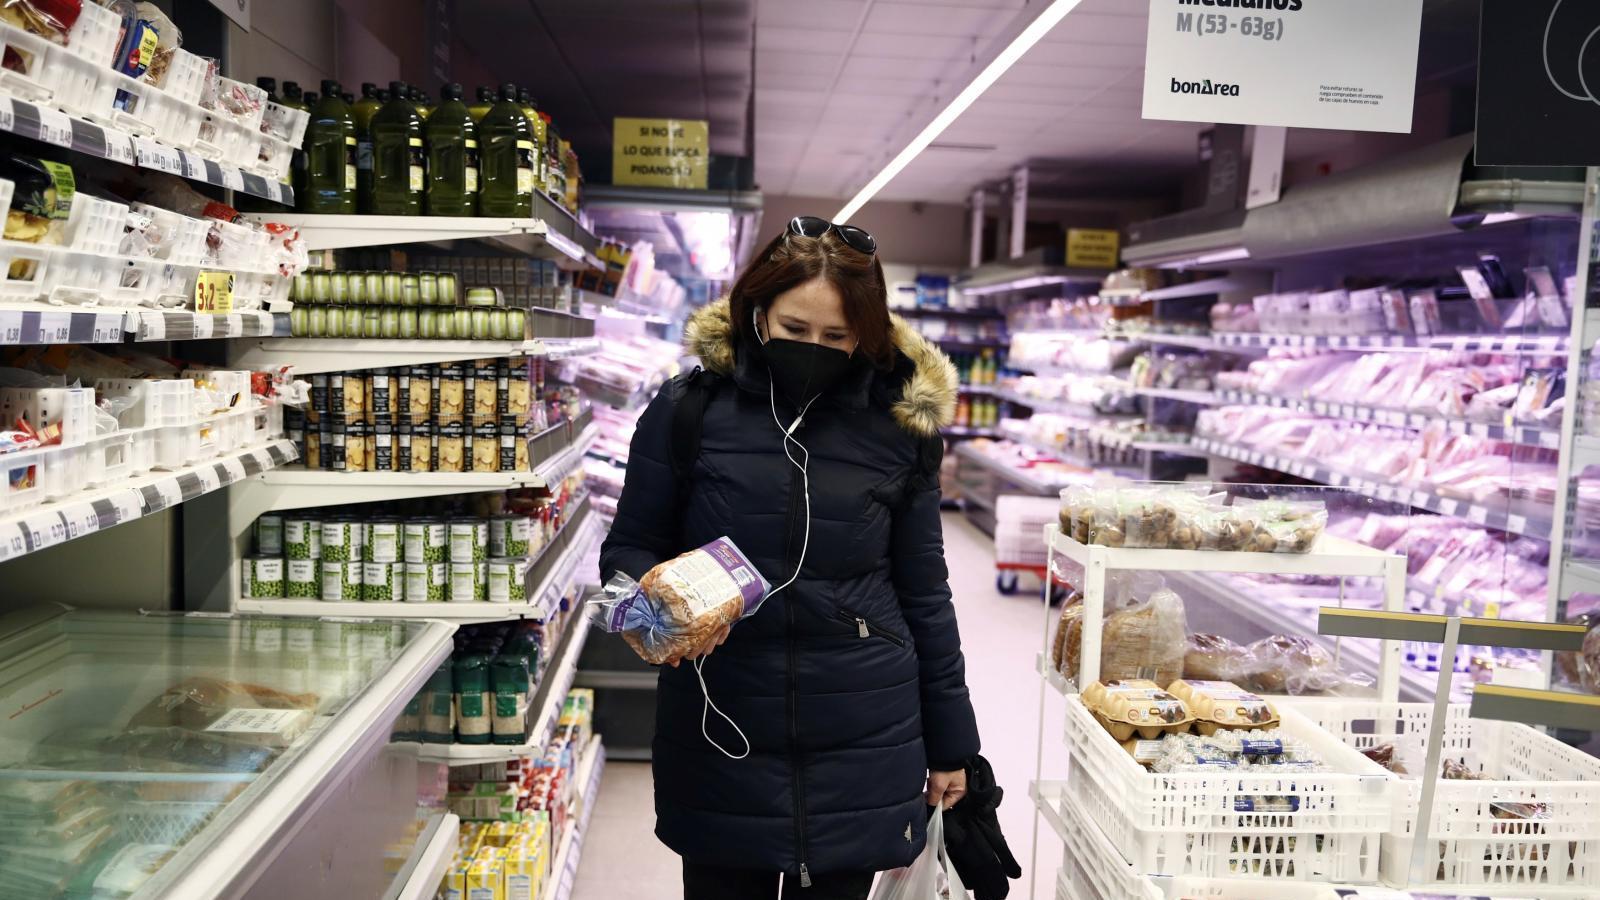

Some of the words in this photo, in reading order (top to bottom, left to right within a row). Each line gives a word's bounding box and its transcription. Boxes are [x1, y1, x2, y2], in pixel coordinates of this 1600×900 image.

[1178, 0, 1303, 11] anos
[1176, 12, 1193, 33] M
[1196, 13, 1228, 36] (53
[1240, 16, 1284, 41] 63g)
[640, 127, 650, 137] SI
[652, 127, 669, 138] NO
[623, 145, 638, 156] LO
[639, 145, 662, 157] QUE
[665, 147, 700, 158] BUSCA
